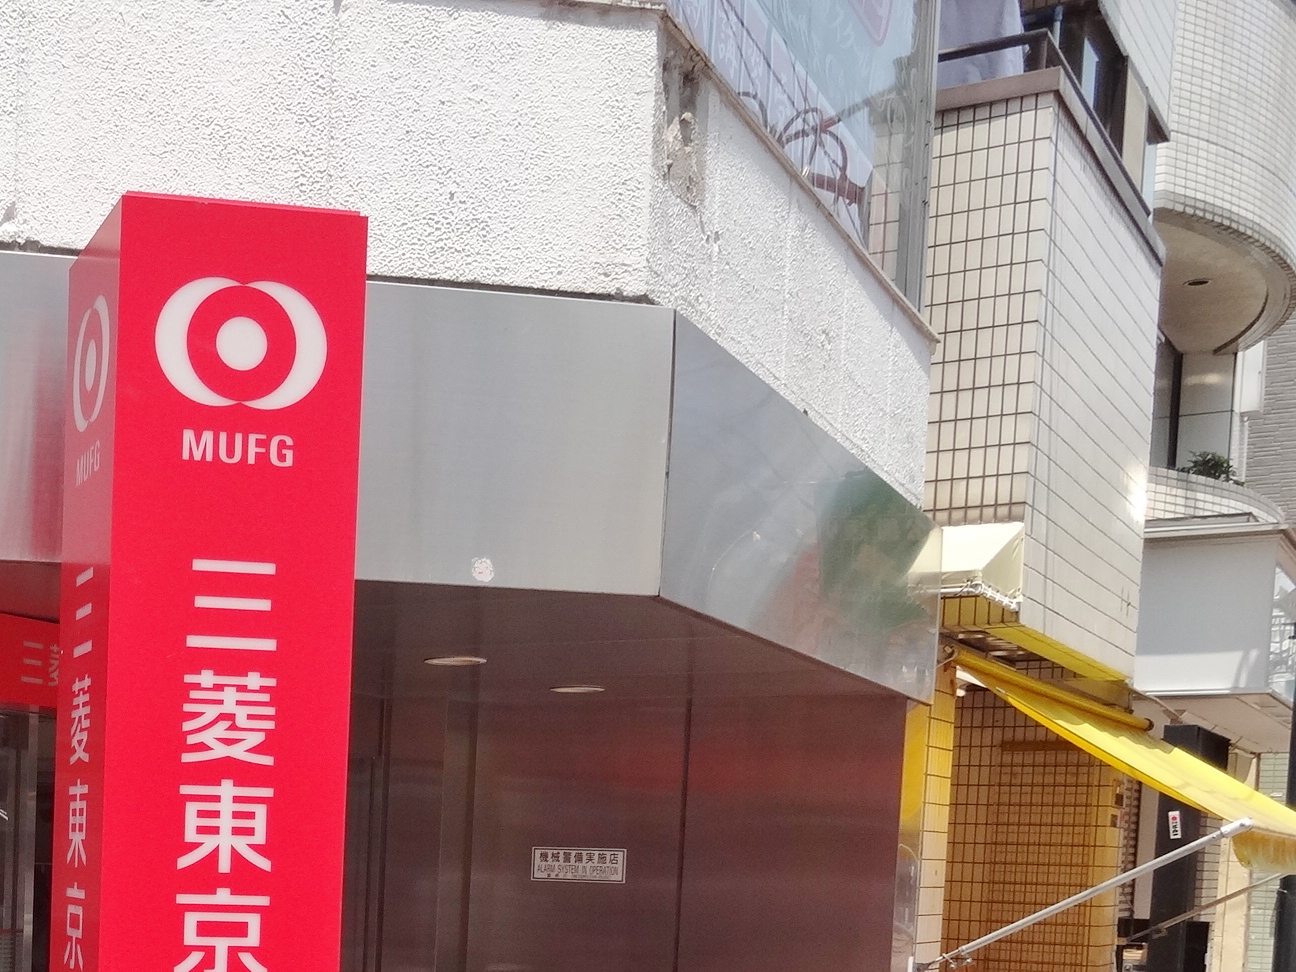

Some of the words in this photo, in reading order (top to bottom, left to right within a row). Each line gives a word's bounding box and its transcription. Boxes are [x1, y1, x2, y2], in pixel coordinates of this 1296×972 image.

[181, 428, 294, 468] MUFG
[75, 440, 101, 487] MUFG
[537, 864, 555, 873] ALARM
[557, 865, 579, 874] SYSTEM
[581, 865, 587, 875] IN
[589, 866, 618, 876] OPERATION
[539, 851, 619, 865] 機械警備実施店
